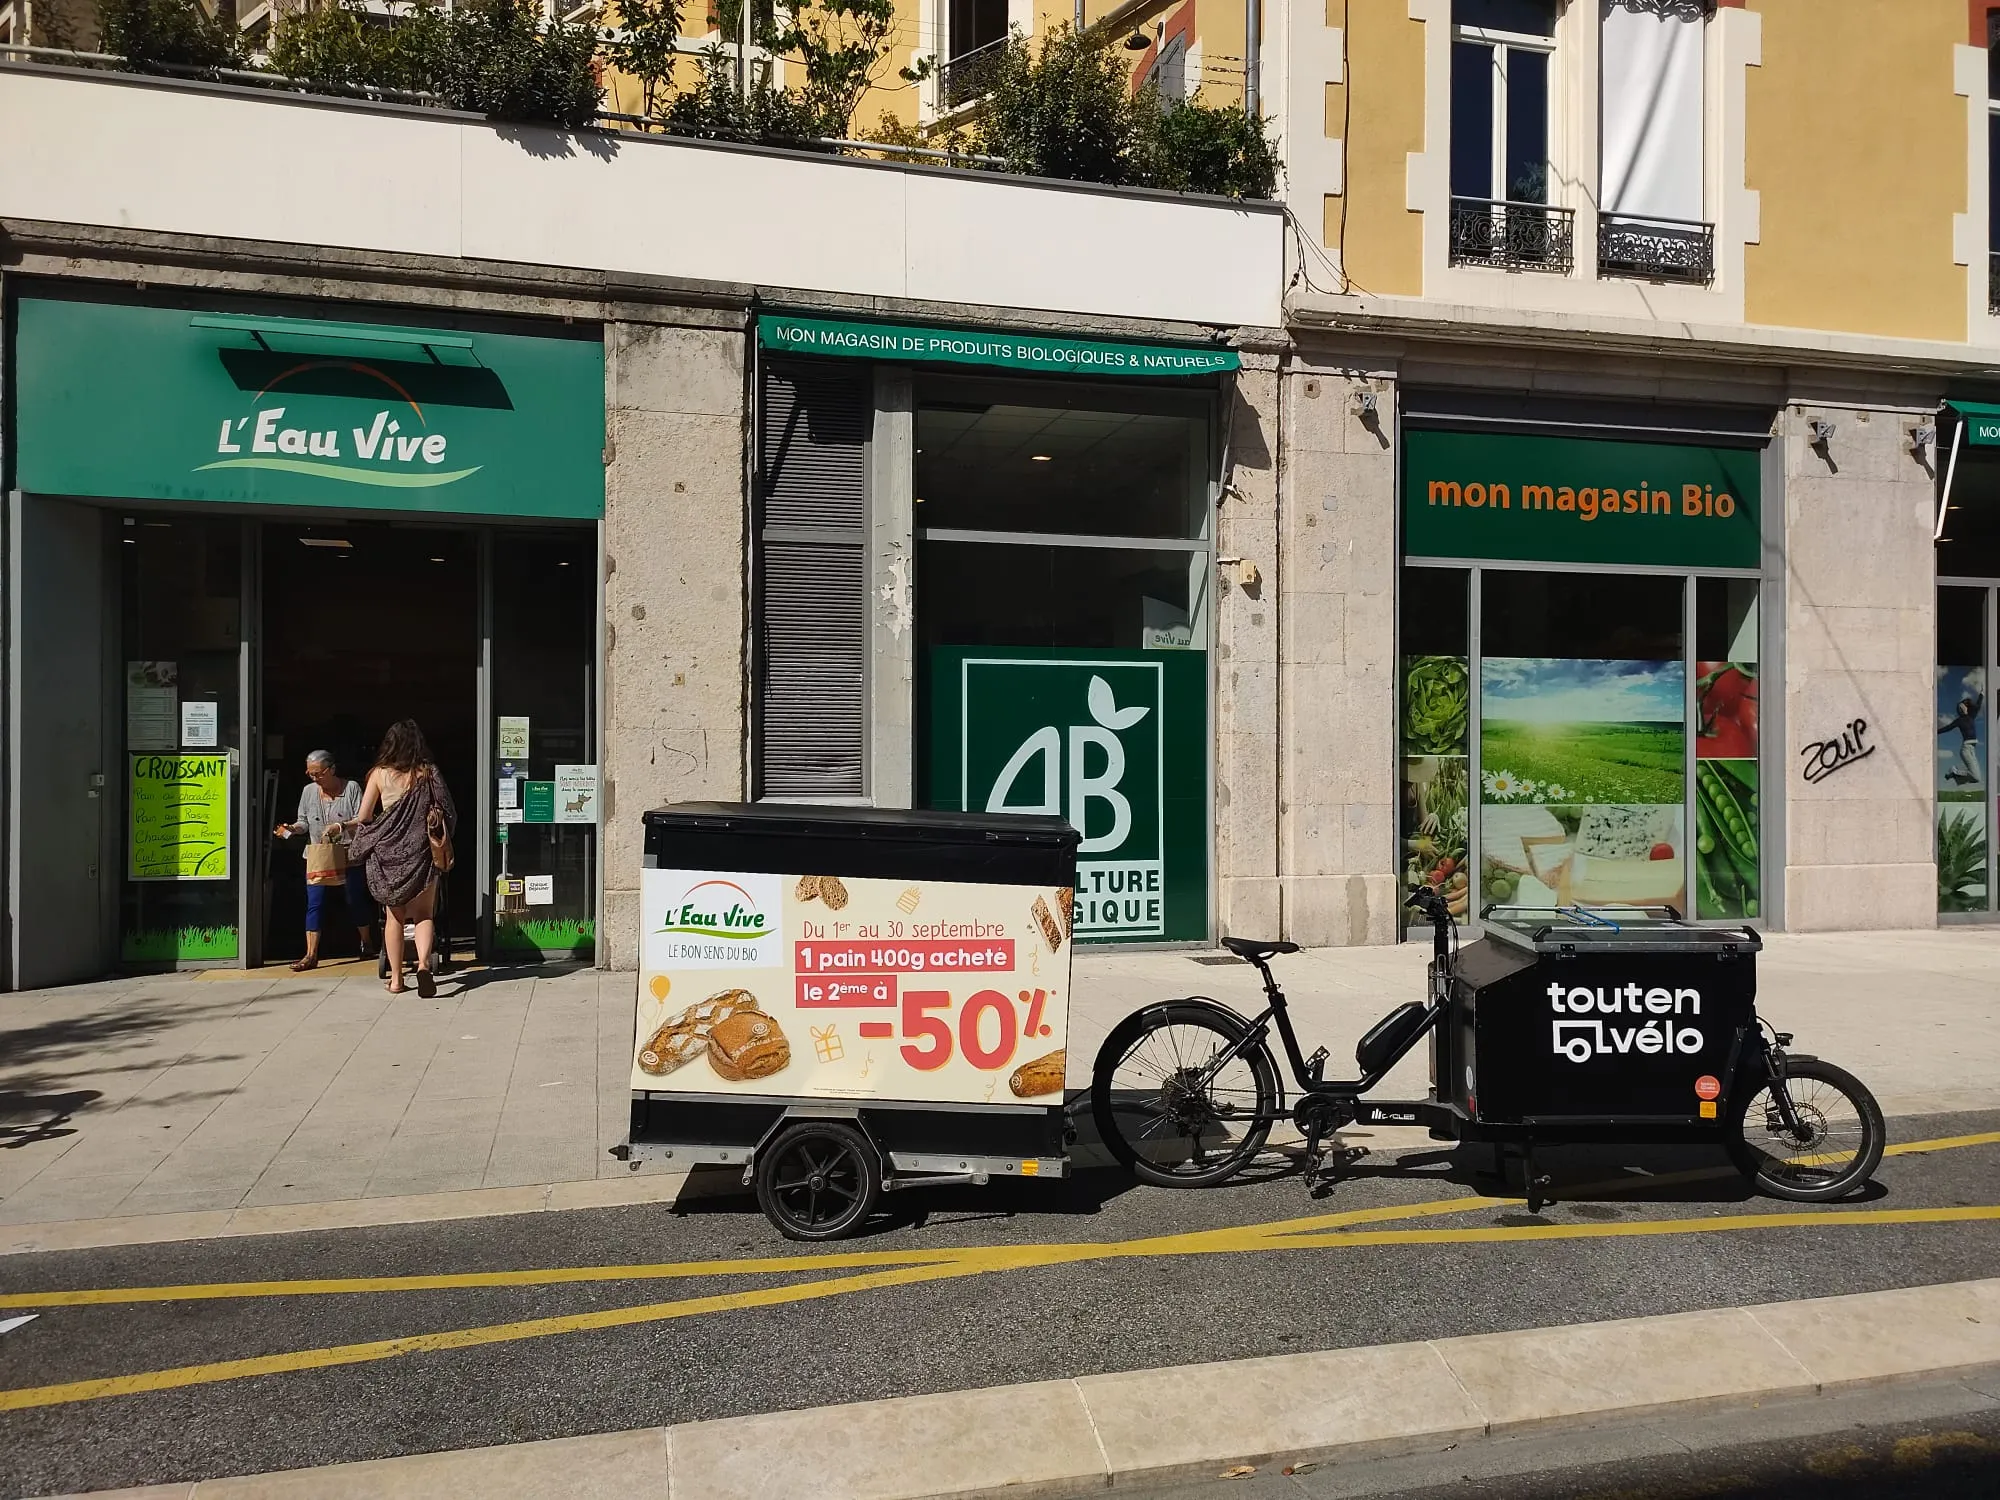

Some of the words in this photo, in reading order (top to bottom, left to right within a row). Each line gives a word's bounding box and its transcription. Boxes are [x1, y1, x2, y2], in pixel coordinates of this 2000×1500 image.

[777, 326, 815, 343] MON
[821, 331, 897, 350] MAGASIN
[902, 337, 925, 351] DE
[929, 339, 1012, 358] PRODUITS
[1017, 346, 1125, 366] BIOLOGIQUES
[1129, 354, 1140, 367] &
[1144, 355, 1226, 368] NATURELS
[218, 407, 340, 457] L'Eau
[352, 410, 447, 464] Vive
[1980, 426, 2000, 438] MO
[1427, 479, 1511, 509] mon
[1521, 481, 1671, 521] magasin
[1682, 483, 1735, 518] Bio
[135, 756, 227, 780] CROISSANT
[985, 726, 1132, 853] AB
[665, 904, 717, 926] L'Eau
[723, 904, 764, 927] Vive
[803, 921, 824, 939] Du
[833, 921, 851, 938] 1er
[858, 924, 879, 938] au
[888, 921, 904, 938] 30
[912, 918, 1005, 940] septembre
[668, 944, 678, 958] LE
[681, 945, 701, 959] BON
[703, 946, 724, 960] SENS
[727, 947, 740, 960] DU
[742, 947, 758, 961] BIO
[801, 947, 812, 968] 1
[819, 949, 866, 971] pain
[871, 949, 925, 970] 400g
[929, 947, 1008, 966] acheté
[803, 983, 823, 1001] le
[873, 981, 888, 1000] à
[1547, 981, 1701, 1015] touten
[1609, 1020, 1704, 1055] vélo
